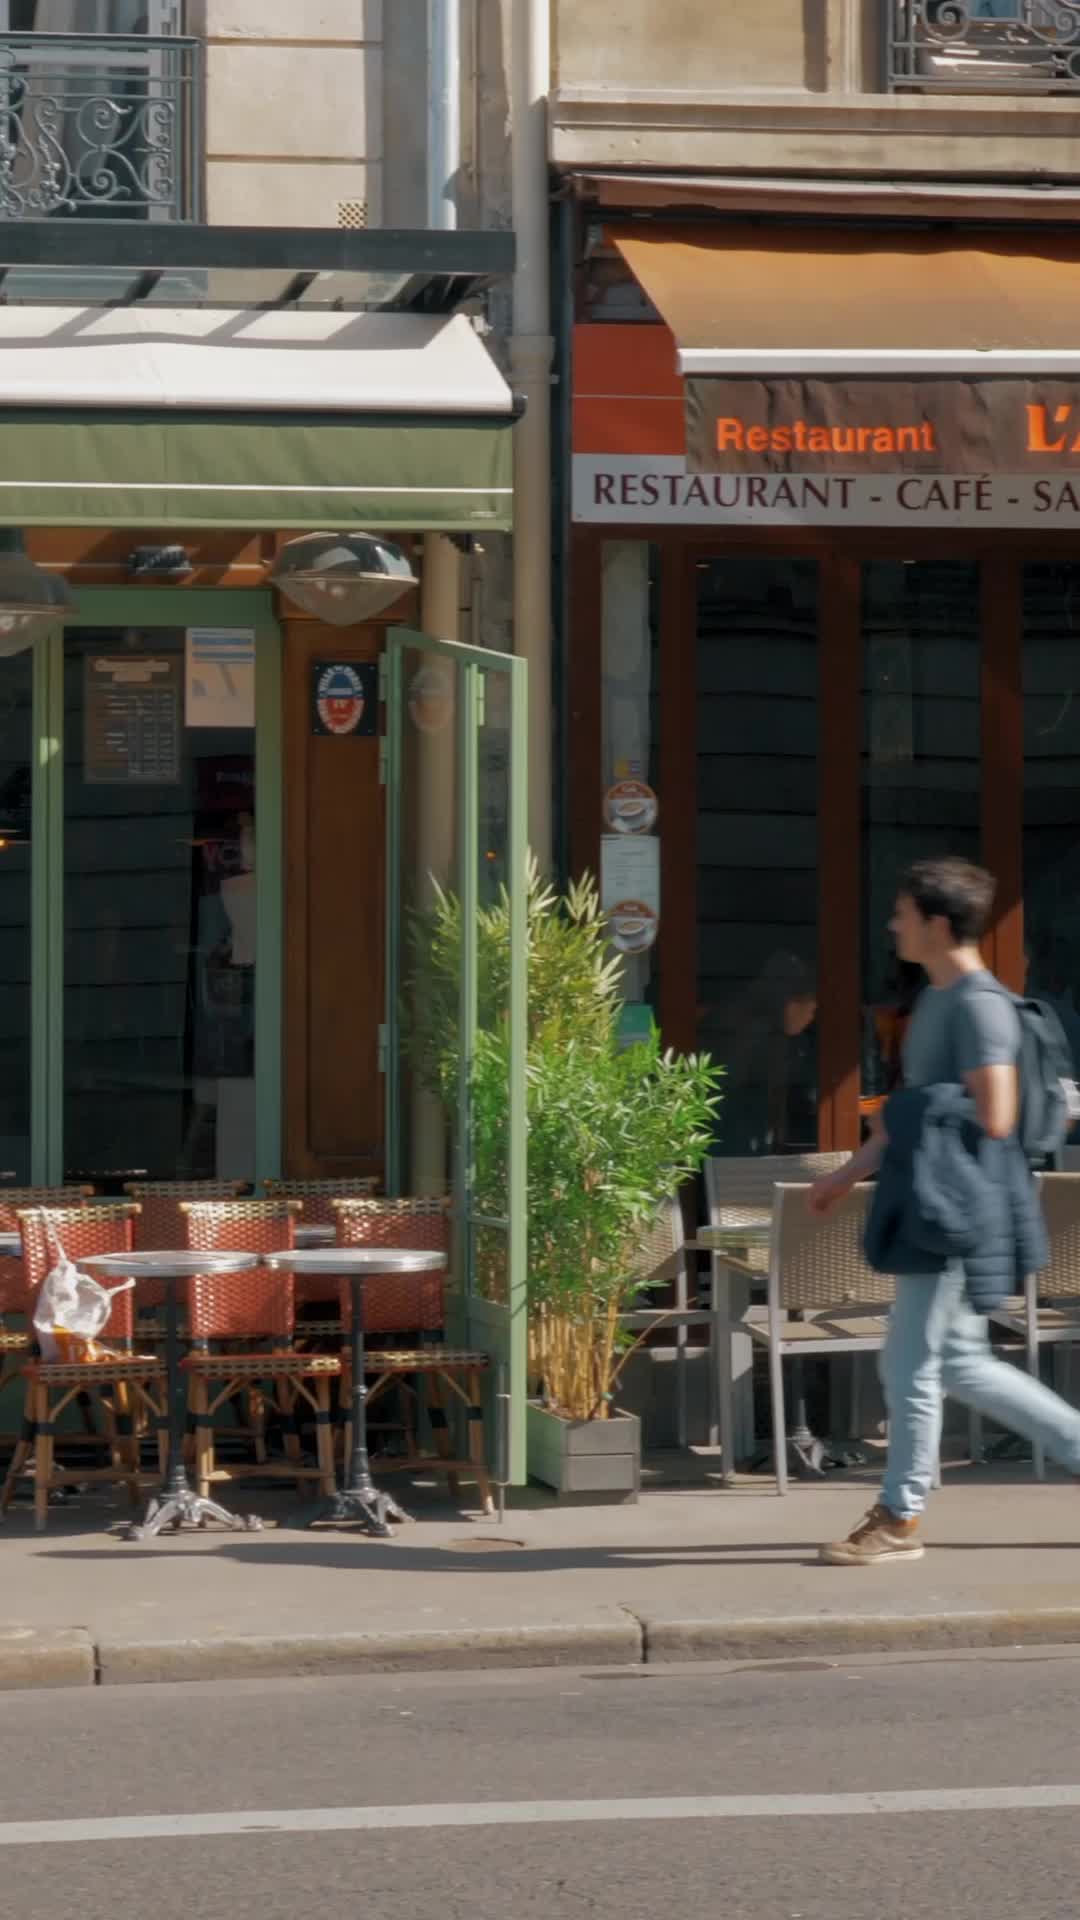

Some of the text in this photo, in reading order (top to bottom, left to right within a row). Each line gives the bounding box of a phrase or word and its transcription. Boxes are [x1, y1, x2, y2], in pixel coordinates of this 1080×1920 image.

[716, 404, 1080, 454] Restaurant L'
[593, 474, 856, 509] RESTAURANT
[896, 473, 992, 511] CAFÉ
[1033, 480, 1080, 512] SA
